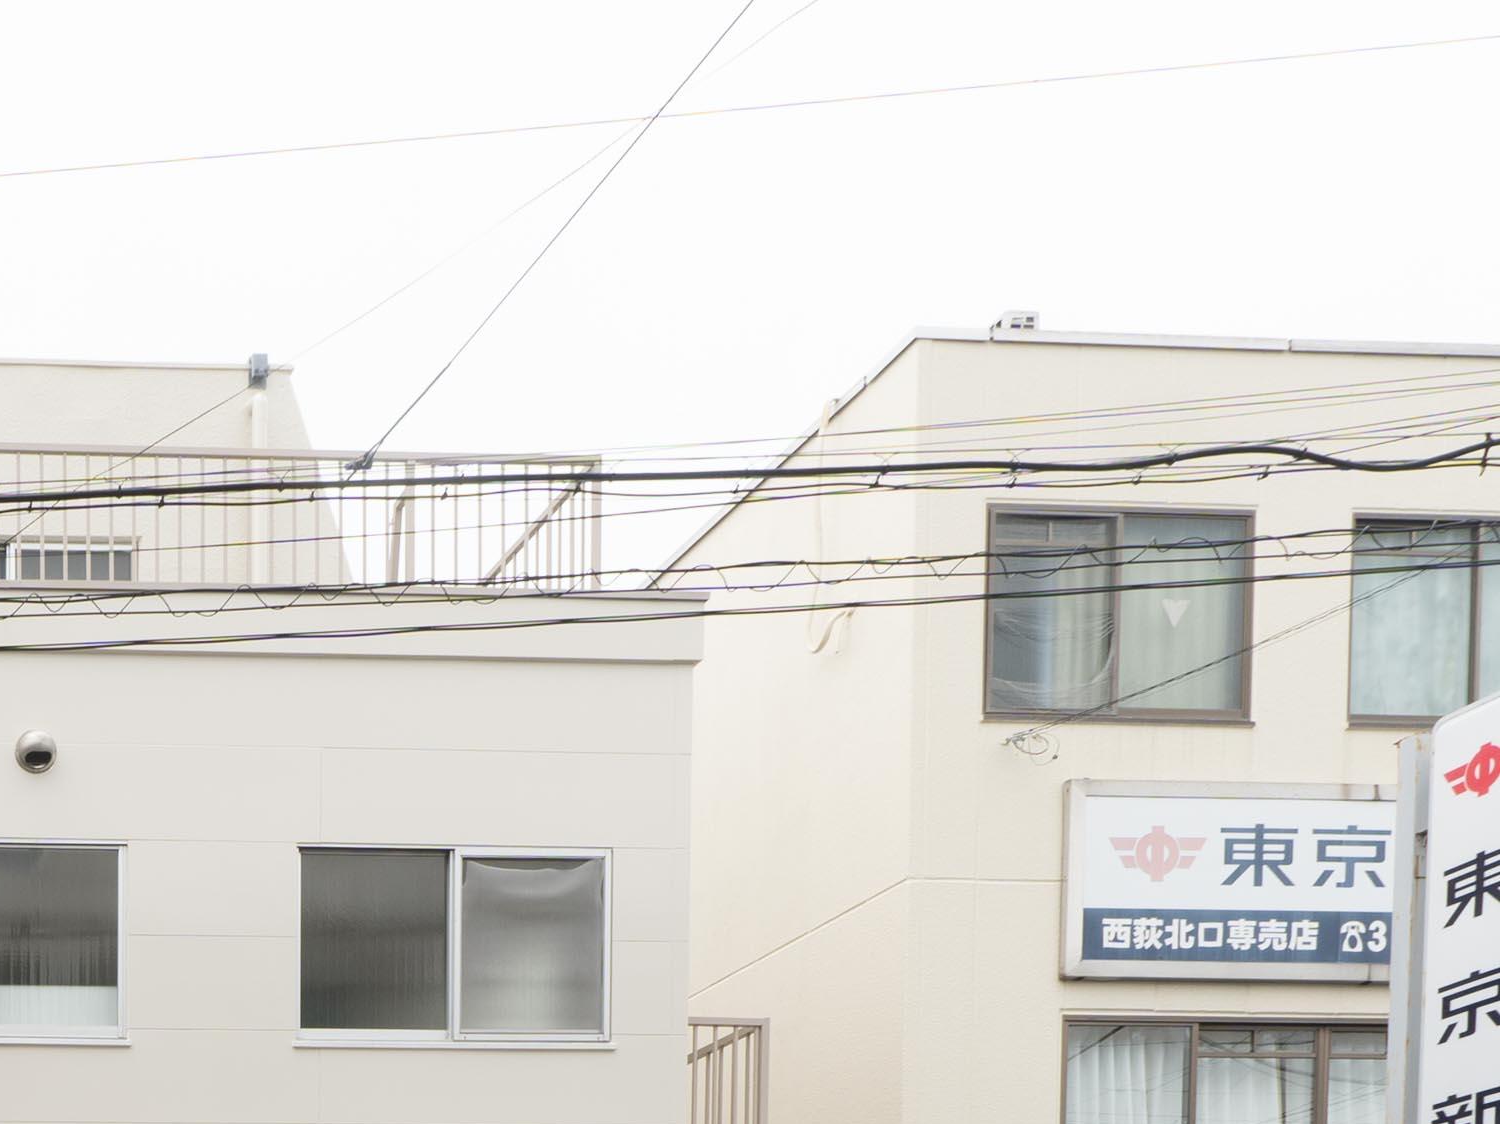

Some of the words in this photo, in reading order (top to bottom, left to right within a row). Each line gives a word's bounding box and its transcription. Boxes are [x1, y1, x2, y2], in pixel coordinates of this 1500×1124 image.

[1220, 824, 1392, 888] 東京
[1102, 917, 1320, 952] 西荻北口専売店
